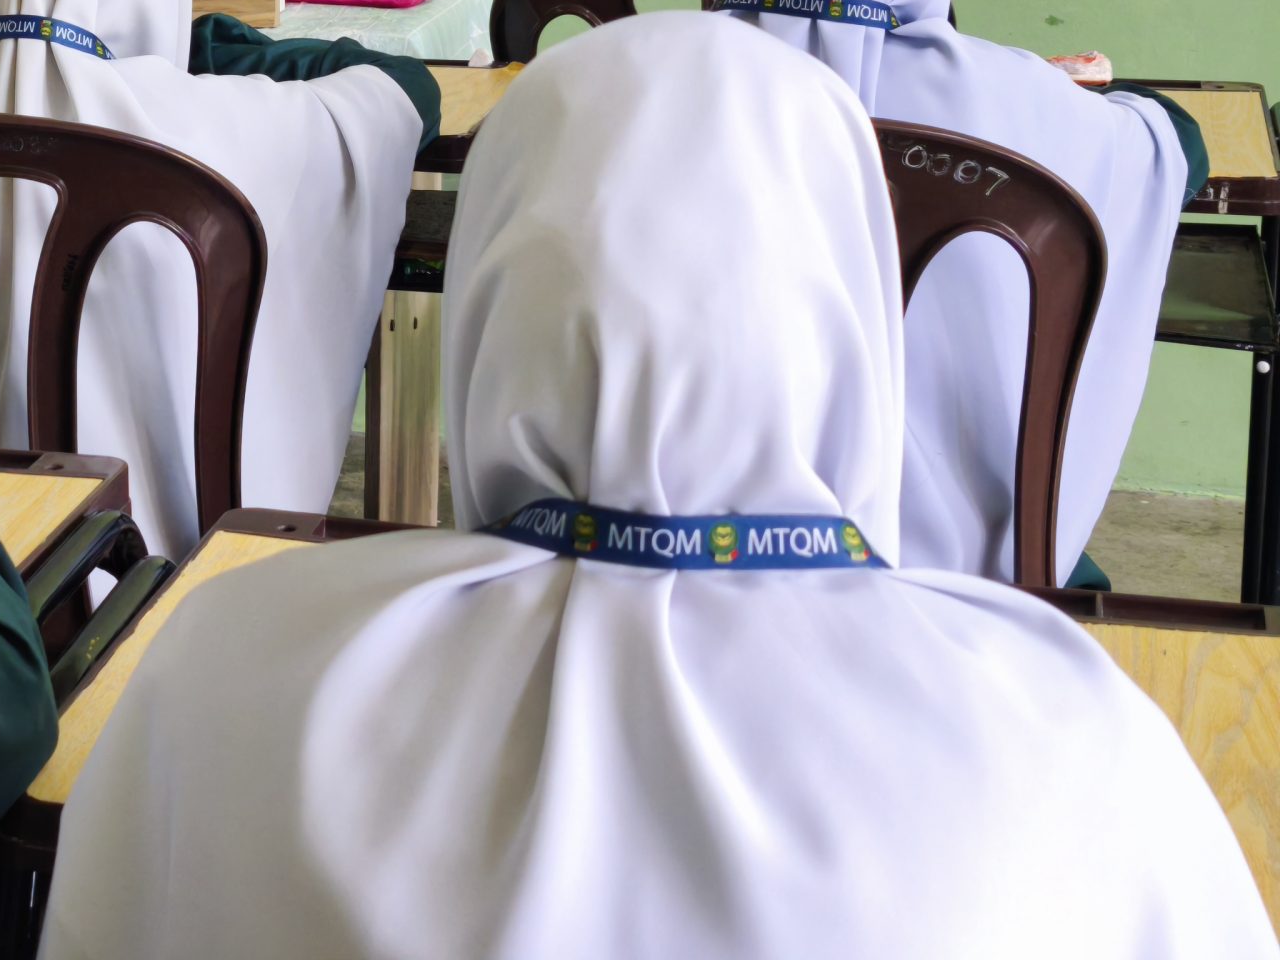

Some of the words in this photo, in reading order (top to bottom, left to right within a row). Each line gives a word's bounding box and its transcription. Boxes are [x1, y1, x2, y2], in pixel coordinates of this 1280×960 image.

[847, 3, 888, 22] MTQM
[56, 25, 93, 49] MTQM
[608, 522, 702, 558] MTQM
[747, 526, 838, 558] MTQM
